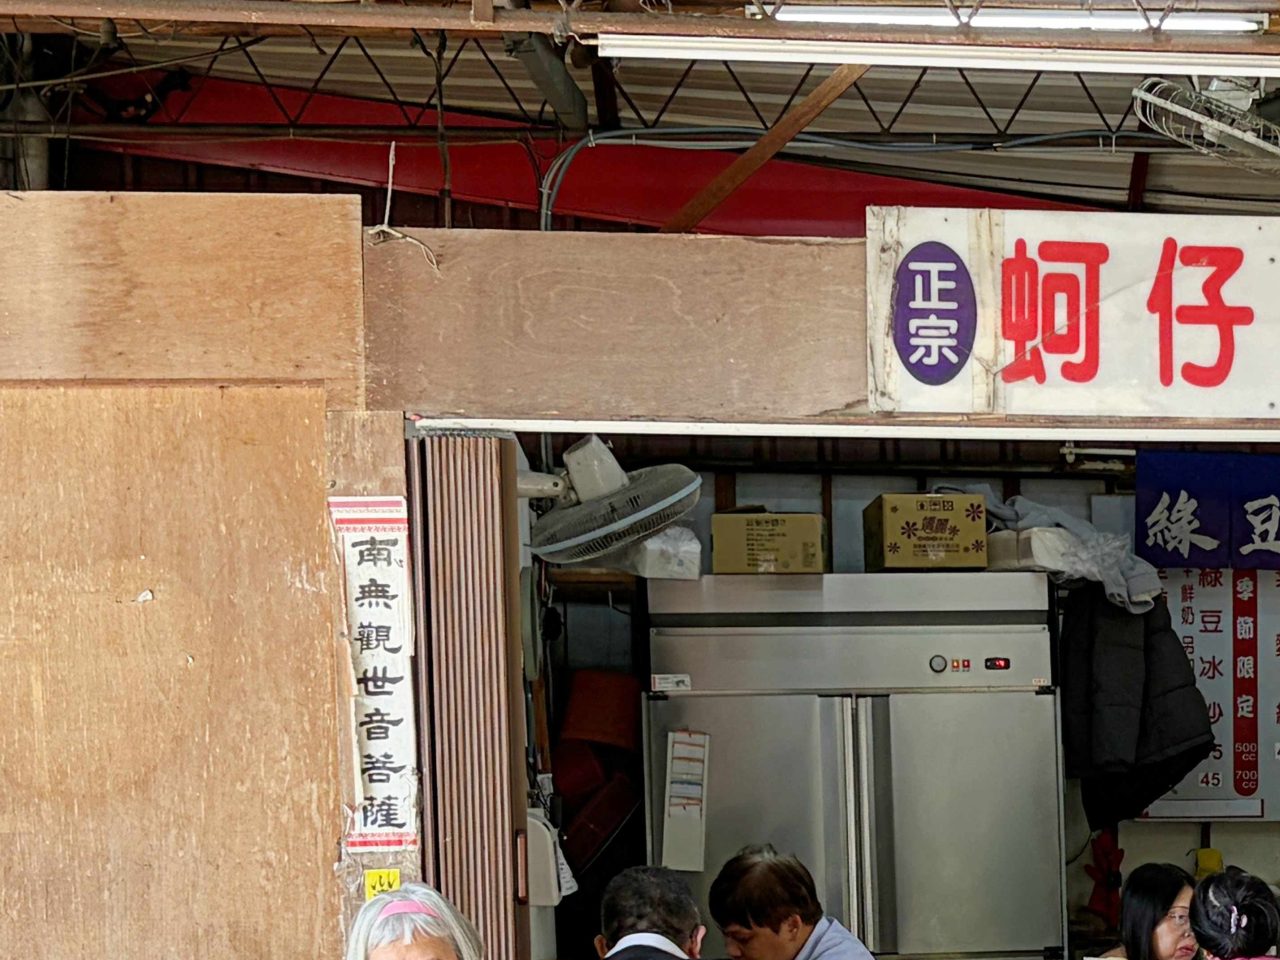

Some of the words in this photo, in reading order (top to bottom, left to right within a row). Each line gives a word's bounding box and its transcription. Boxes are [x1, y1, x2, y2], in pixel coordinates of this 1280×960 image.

[907, 260, 960, 367] 正宗
[1236, 577, 1255, 718] 季節限定
[351, 536, 406, 828] 南無觀世音菩薩
[1235, 743, 1257, 752] 500
[1235, 771, 1258, 780] 700
[1200, 772, 1221, 787] 45
